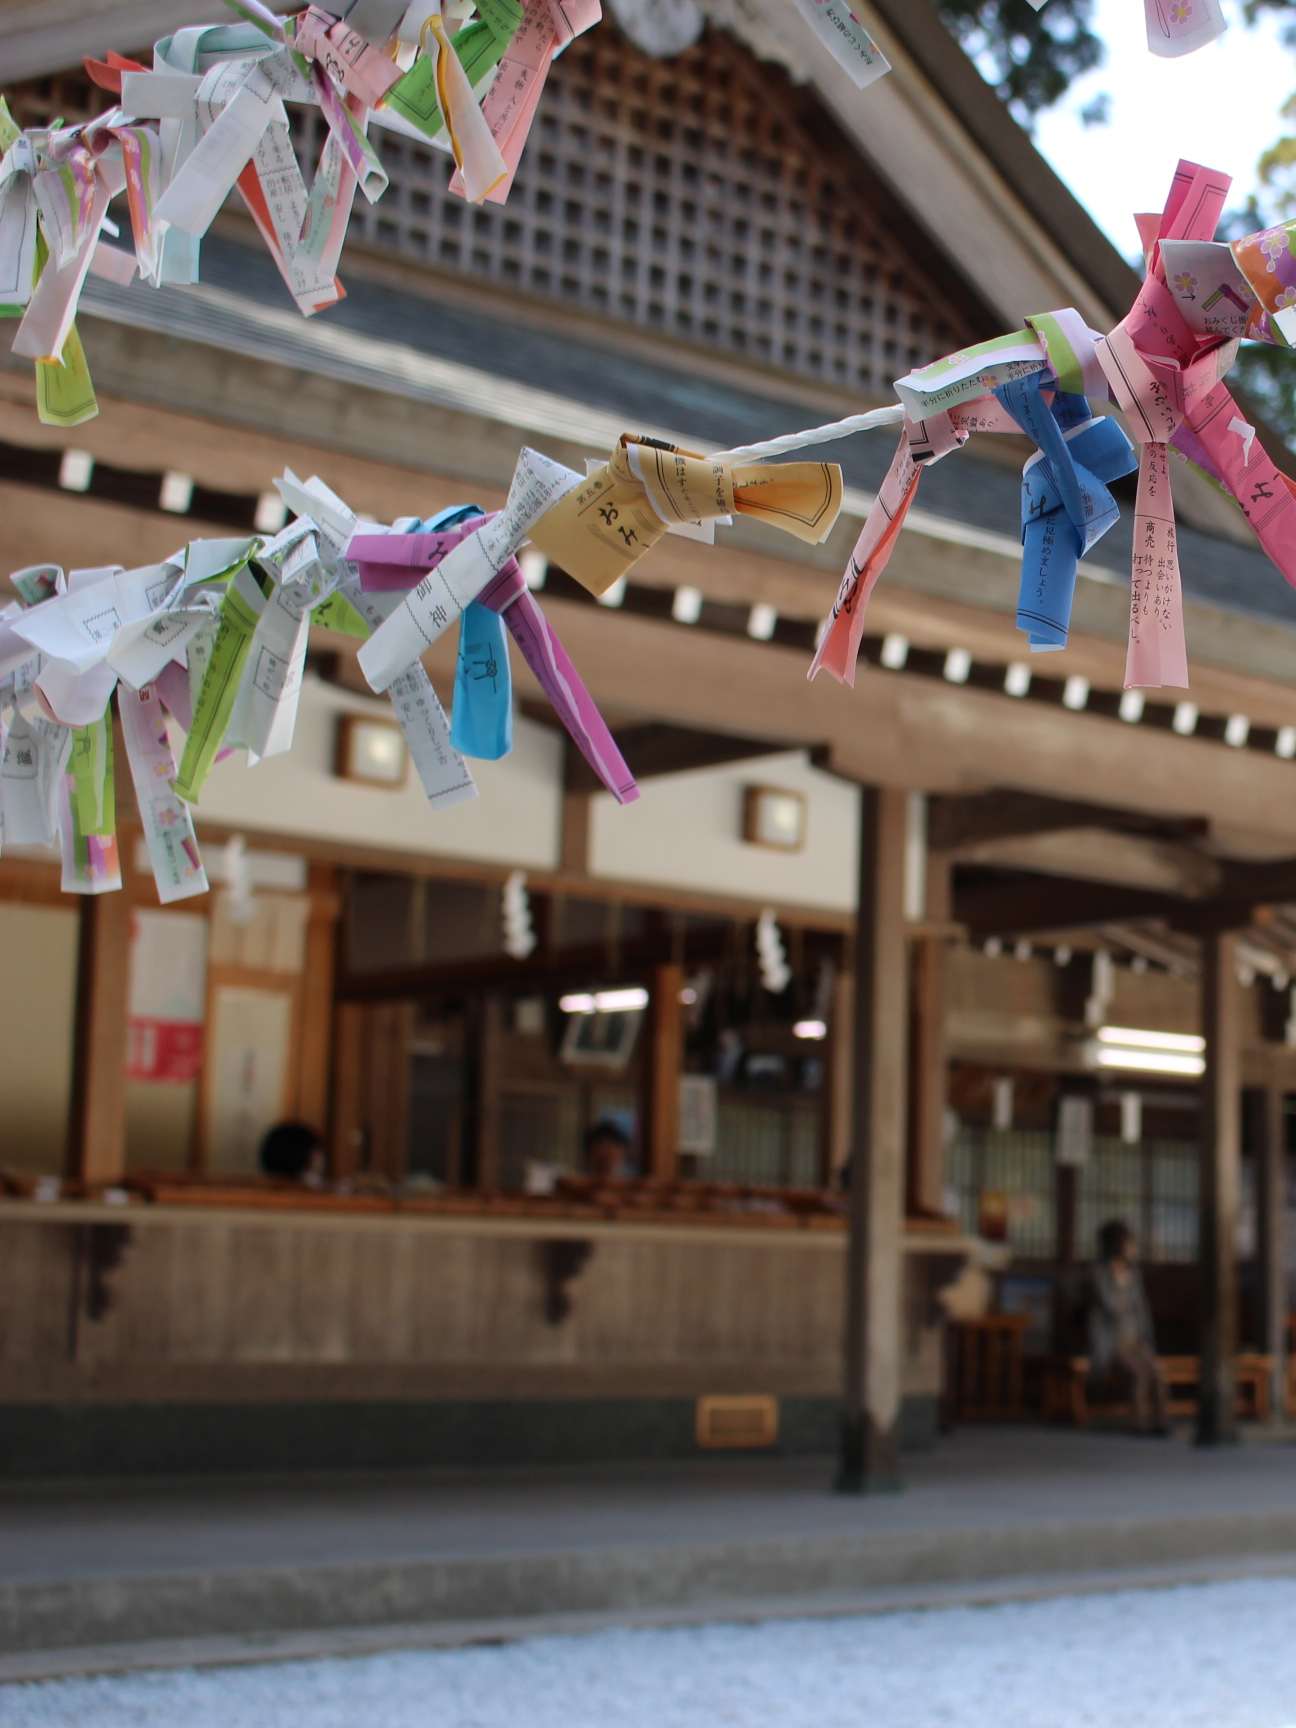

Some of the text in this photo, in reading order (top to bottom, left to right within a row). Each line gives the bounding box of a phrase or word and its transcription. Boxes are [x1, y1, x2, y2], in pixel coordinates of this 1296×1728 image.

[920, 375, 985, 408] 半分に折りたたむ
[1145, 521, 1156, 549] 商売
[1166, 526, 1175, 554] 旅行
[1130, 555, 1144, 645] 打って出るべし。
[1142, 554, 1155, 616] 待つよりも
[1153, 557, 1166, 624] 出会いあり。
[1161, 558, 1175, 631] 思いがけない
